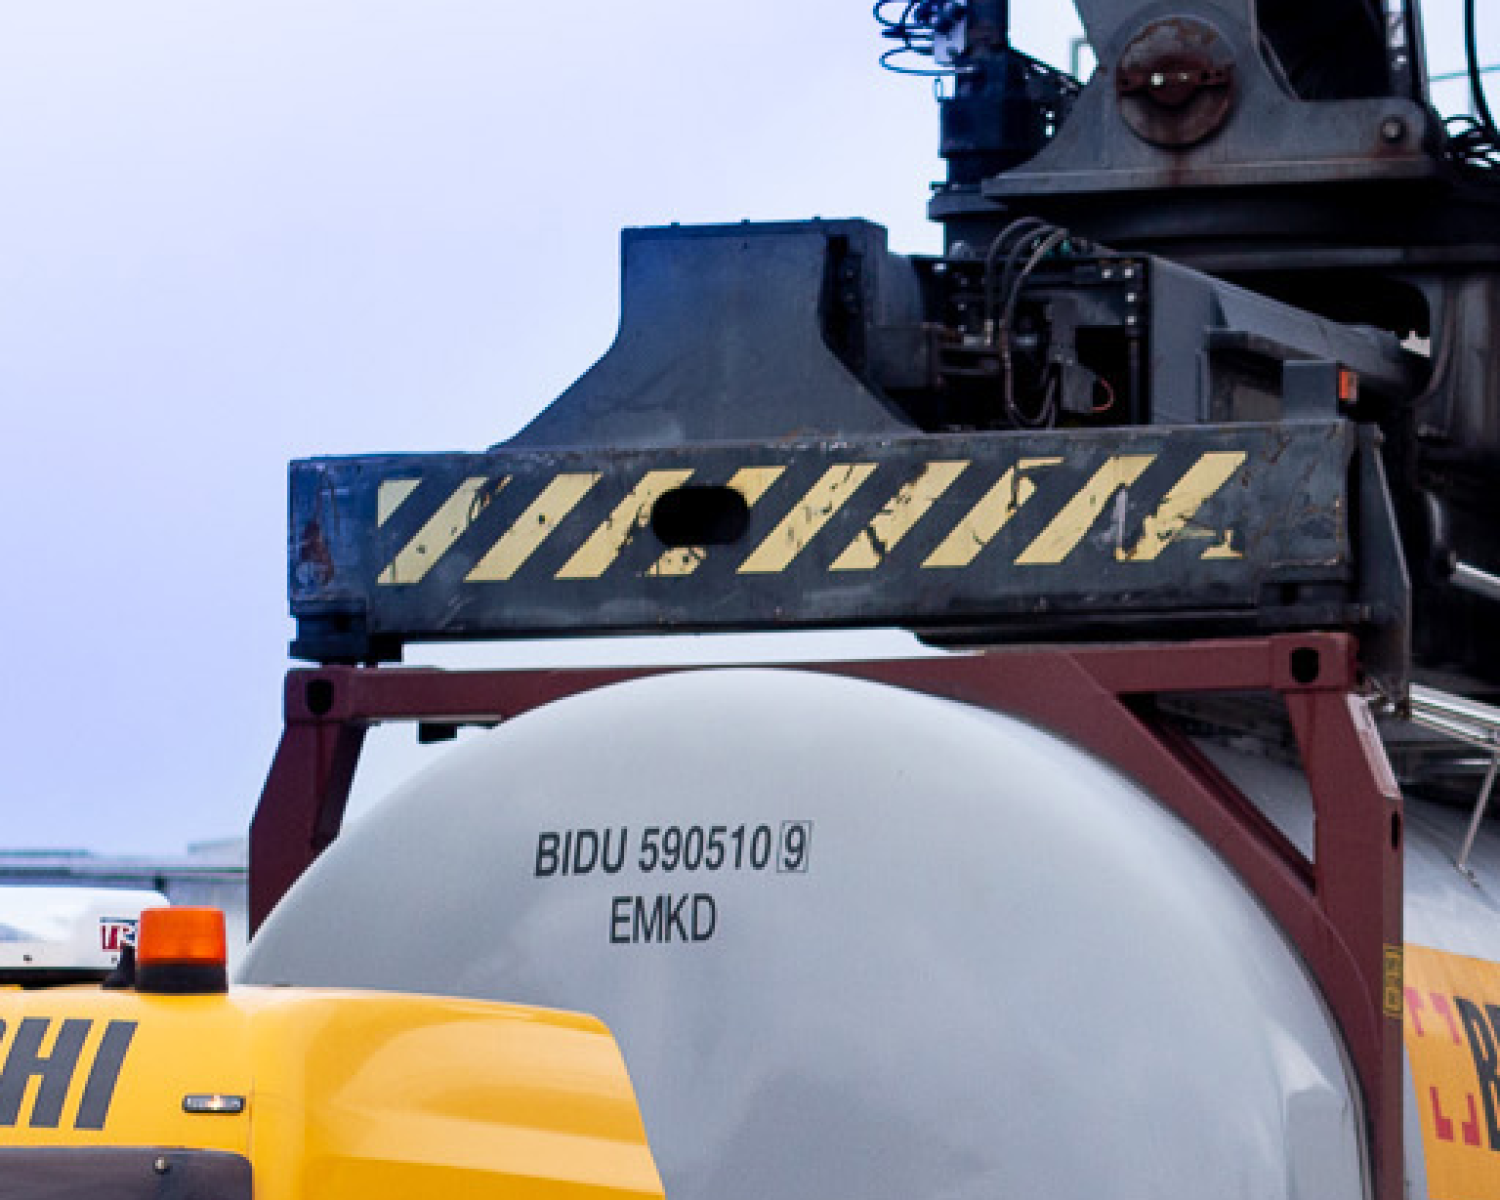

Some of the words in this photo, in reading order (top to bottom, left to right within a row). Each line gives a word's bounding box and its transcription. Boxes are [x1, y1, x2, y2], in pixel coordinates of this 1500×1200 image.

[533, 826, 628, 878] BIDU
[637, 823, 772, 873] 590510
[782, 822, 807, 872] 9
[609, 892, 717, 944] EMKD
